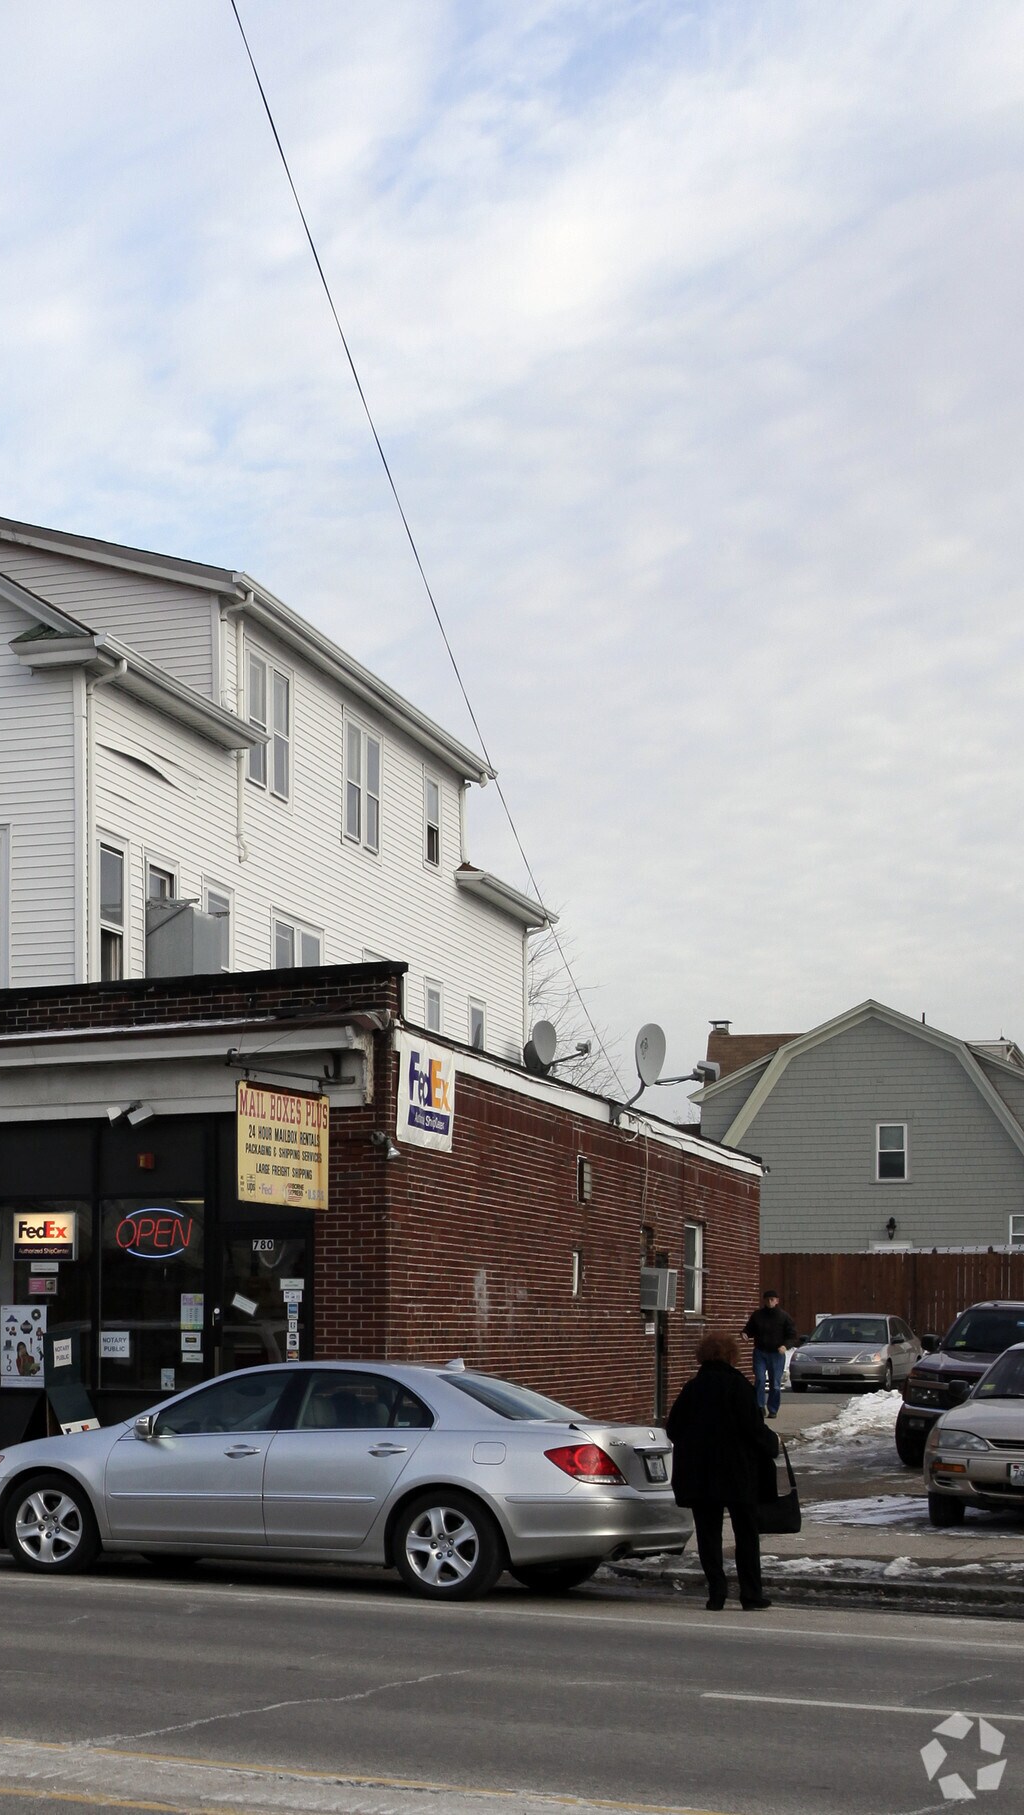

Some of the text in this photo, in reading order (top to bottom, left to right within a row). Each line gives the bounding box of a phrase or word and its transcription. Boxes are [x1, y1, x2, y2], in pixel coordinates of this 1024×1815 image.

[409, 1050, 451, 1112] FedEx
[240, 1089, 328, 1129] MAIL BOXES PLUS
[248, 1124, 320, 1147] 24 HOUR MAILBOX RENTALS
[245, 1143, 272, 1157] PACKAGING
[278, 1147, 301, 1160] SHIPPING
[301, 1150, 322, 1163] SERVICES
[256, 1162, 313, 1180] LARGE FREIGHT SHIPPING
[18, 1220, 68, 1239] FedEx
[116, 1217, 193, 1248] OPEN
[253, 1240, 274, 1250] 780
